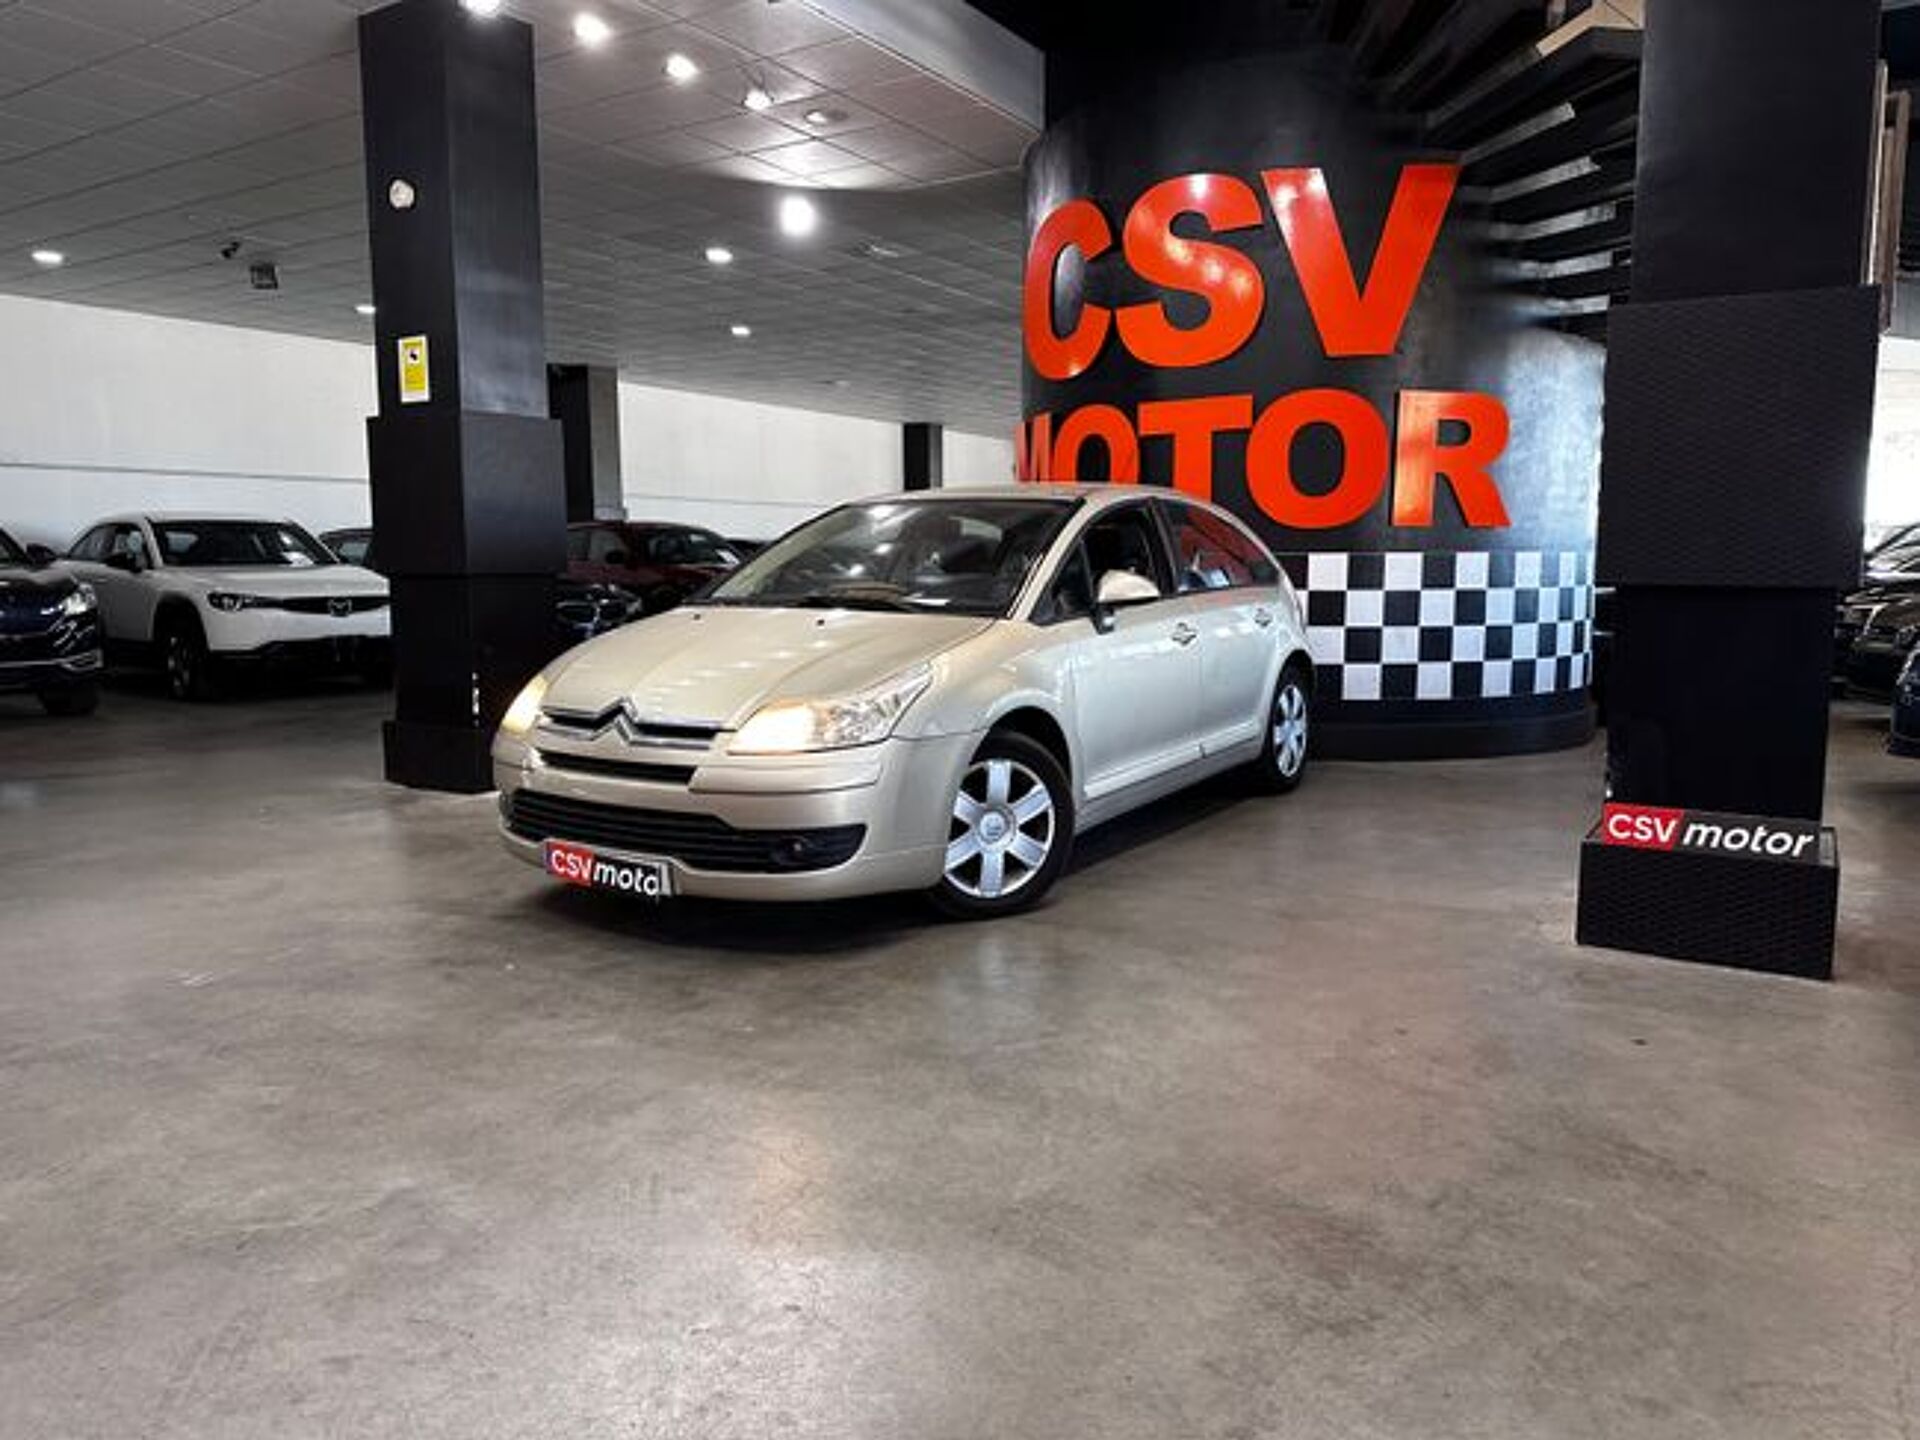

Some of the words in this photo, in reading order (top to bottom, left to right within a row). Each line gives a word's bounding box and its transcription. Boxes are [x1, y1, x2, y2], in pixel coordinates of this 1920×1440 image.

[1021, 165, 1463, 379] CSV
[1607, 813, 1677, 843] CSV
[1682, 821, 1815, 857] motor
[551, 850, 592, 881] CSV
[593, 860, 660, 896] moto
